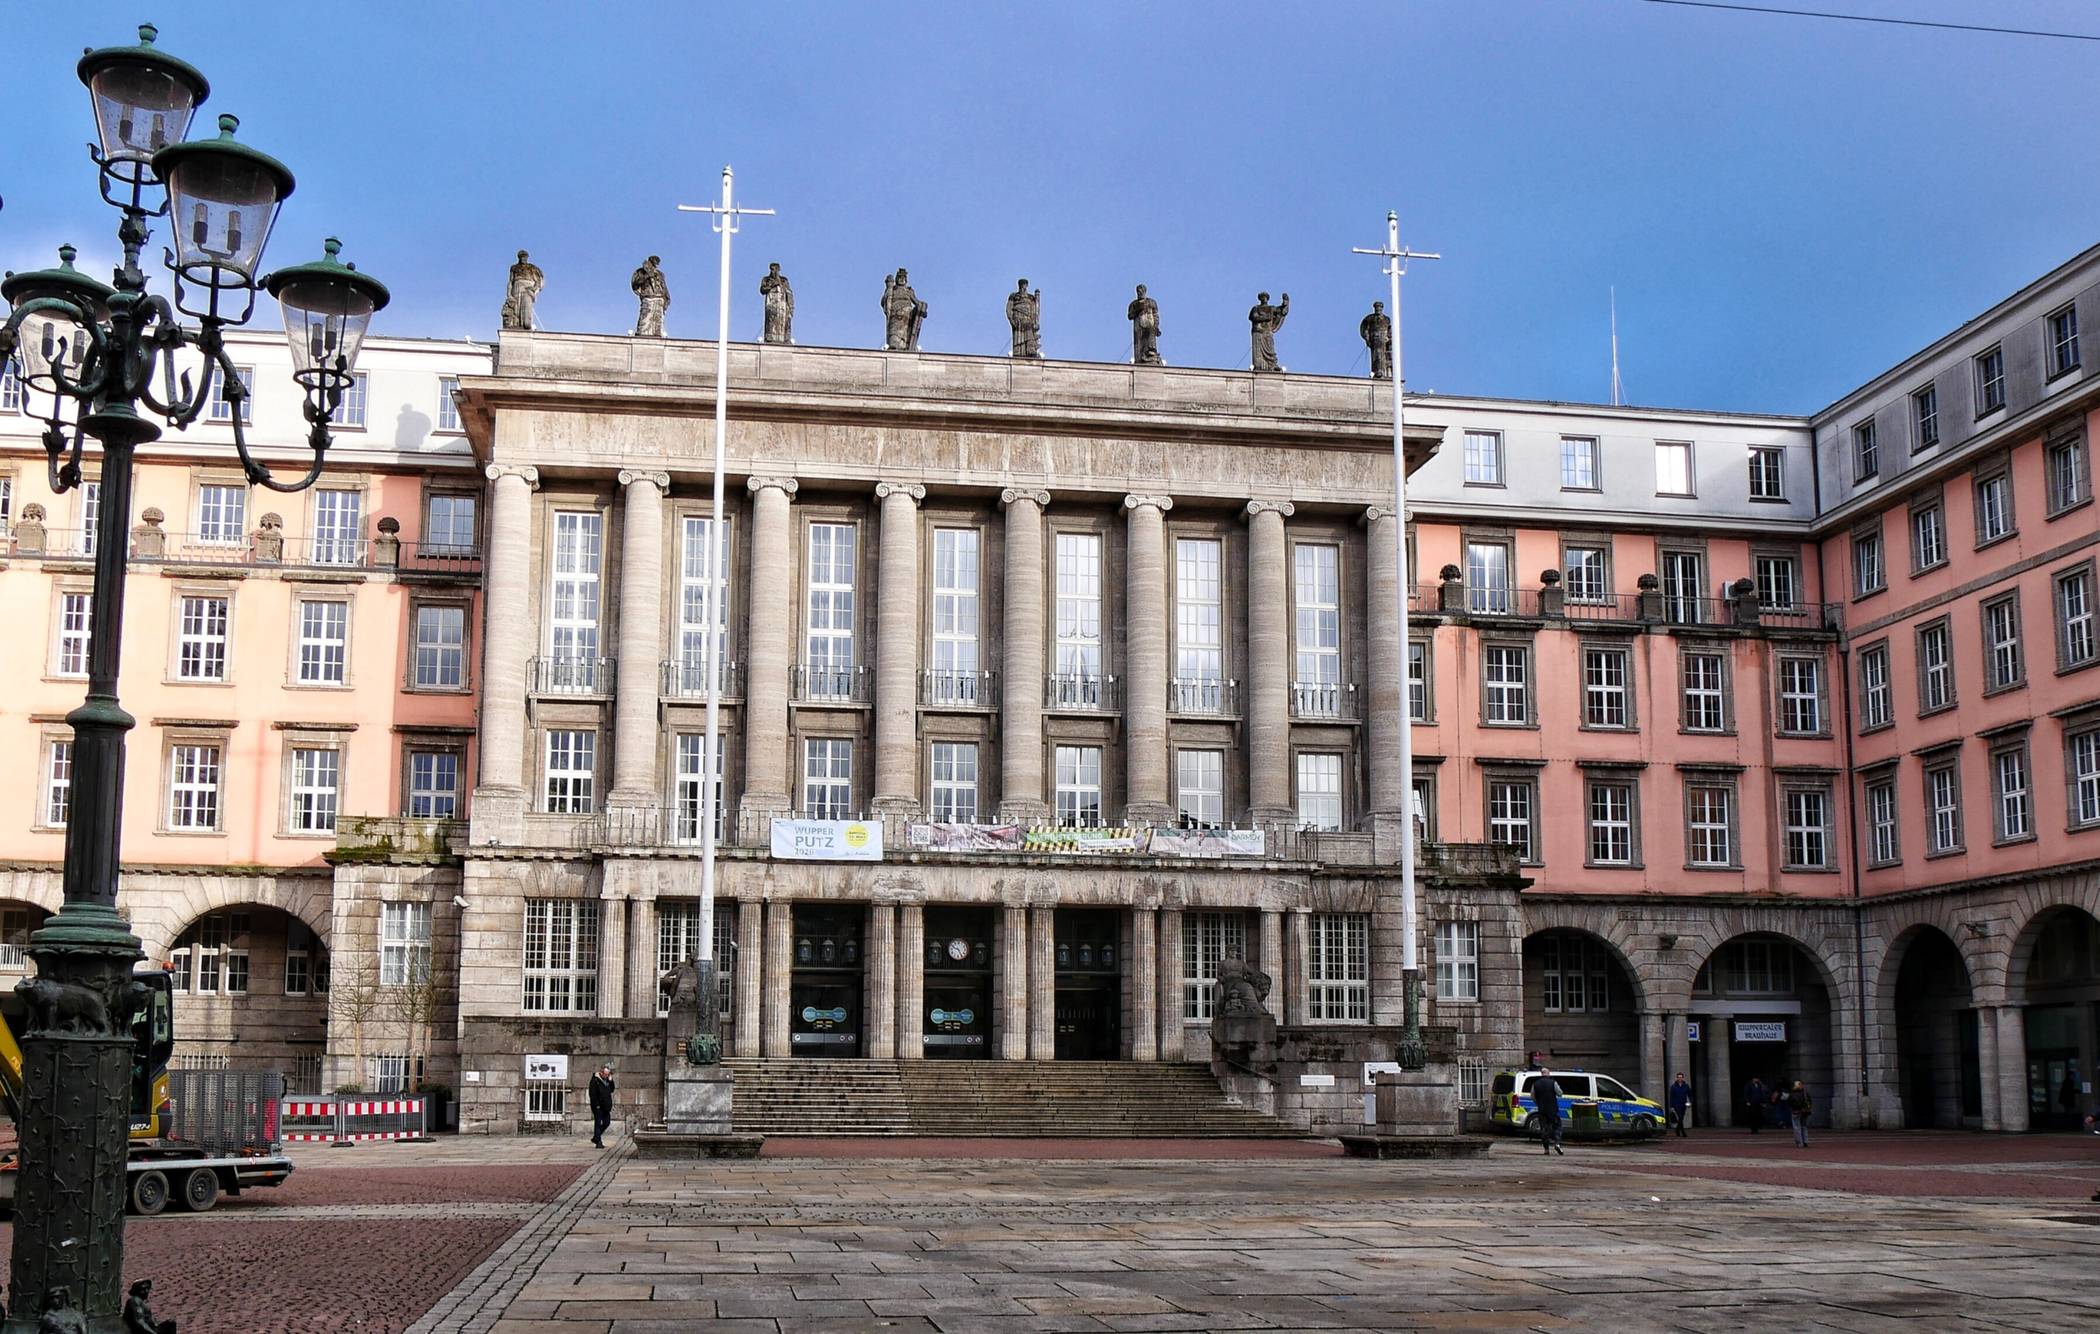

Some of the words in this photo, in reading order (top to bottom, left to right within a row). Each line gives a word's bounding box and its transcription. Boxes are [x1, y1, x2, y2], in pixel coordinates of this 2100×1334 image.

[795, 827, 834, 836] WUPPER
[795, 836, 834, 848] PUTZ
[1744, 1032, 1777, 1040] BRAUHAUS
